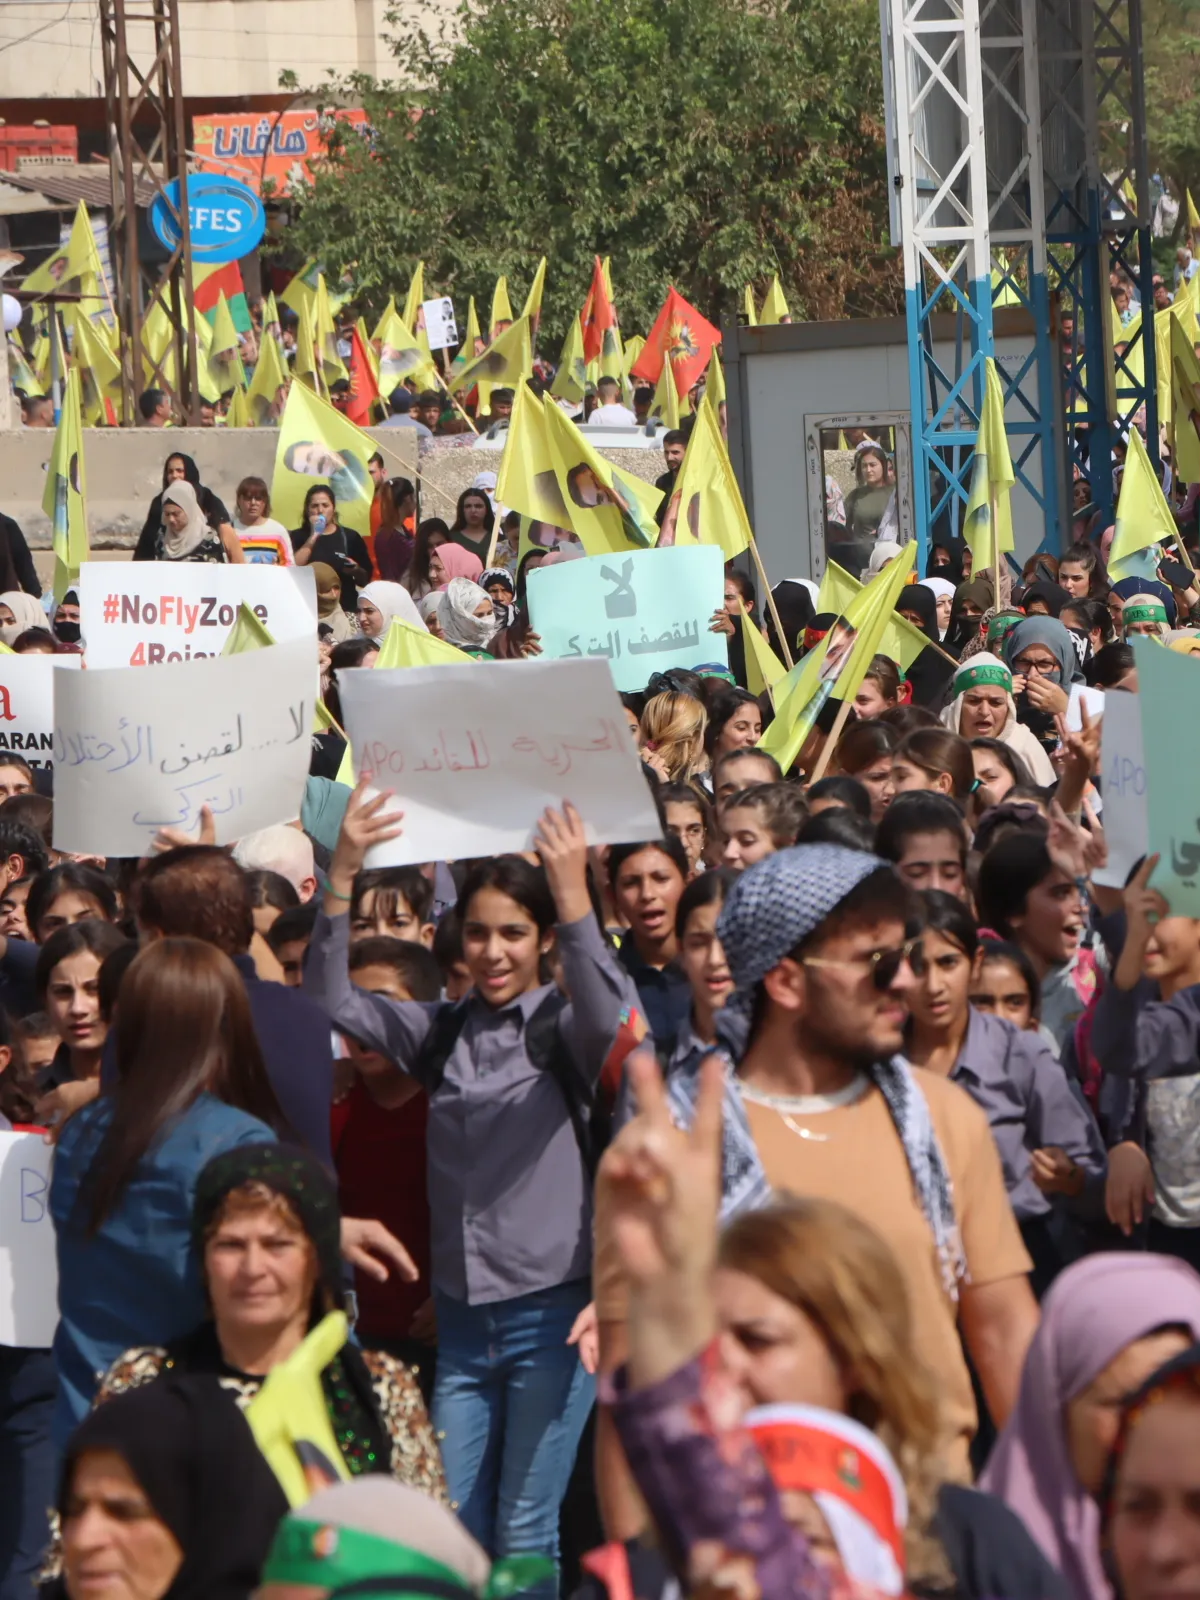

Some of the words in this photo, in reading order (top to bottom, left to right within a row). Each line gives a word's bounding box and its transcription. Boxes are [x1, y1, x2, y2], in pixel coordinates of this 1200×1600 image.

[600, 557, 638, 620] لا
[1131, 608, 1150, 619] APO
[558, 629, 622, 660] التك
[627, 618, 701, 656] للقصف
[980, 668, 1004, 681] APO
[285, 700, 304, 745] لا
[359, 740, 404, 778] APO
[511, 717, 628, 777] الحرية
[1108, 754, 1147, 797] APO
